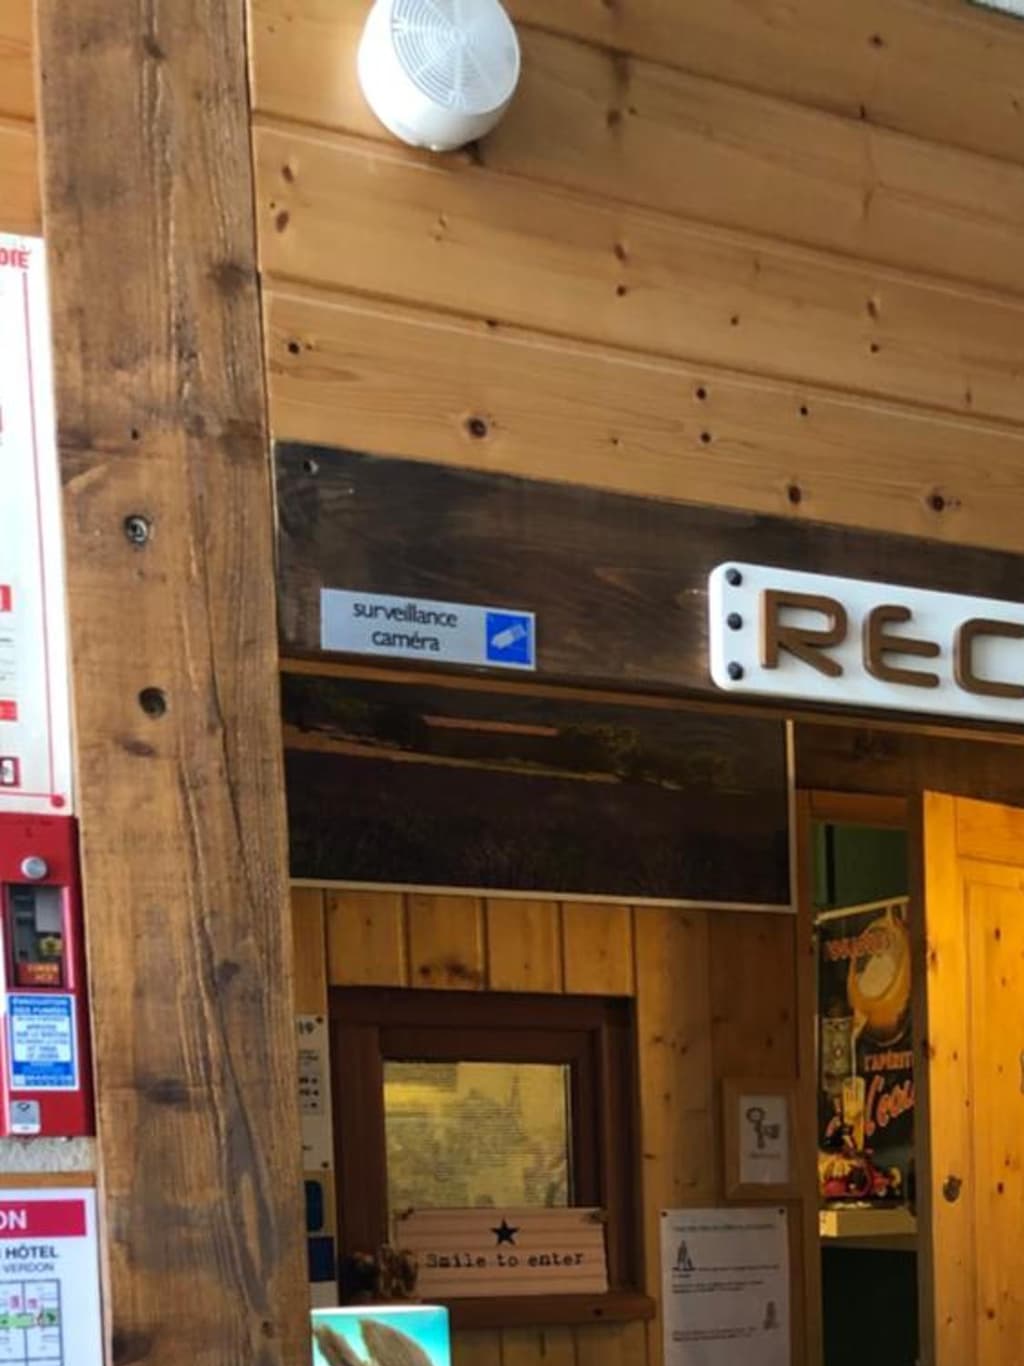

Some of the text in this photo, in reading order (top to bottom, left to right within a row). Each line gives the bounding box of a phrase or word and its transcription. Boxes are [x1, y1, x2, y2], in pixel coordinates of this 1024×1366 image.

[353, 601, 457, 627] surveillance
[372, 630, 440, 652] caméra
[5, 1244, 58, 1260] HÔTEL
[427, 1252, 584, 1269] Smile to enter
